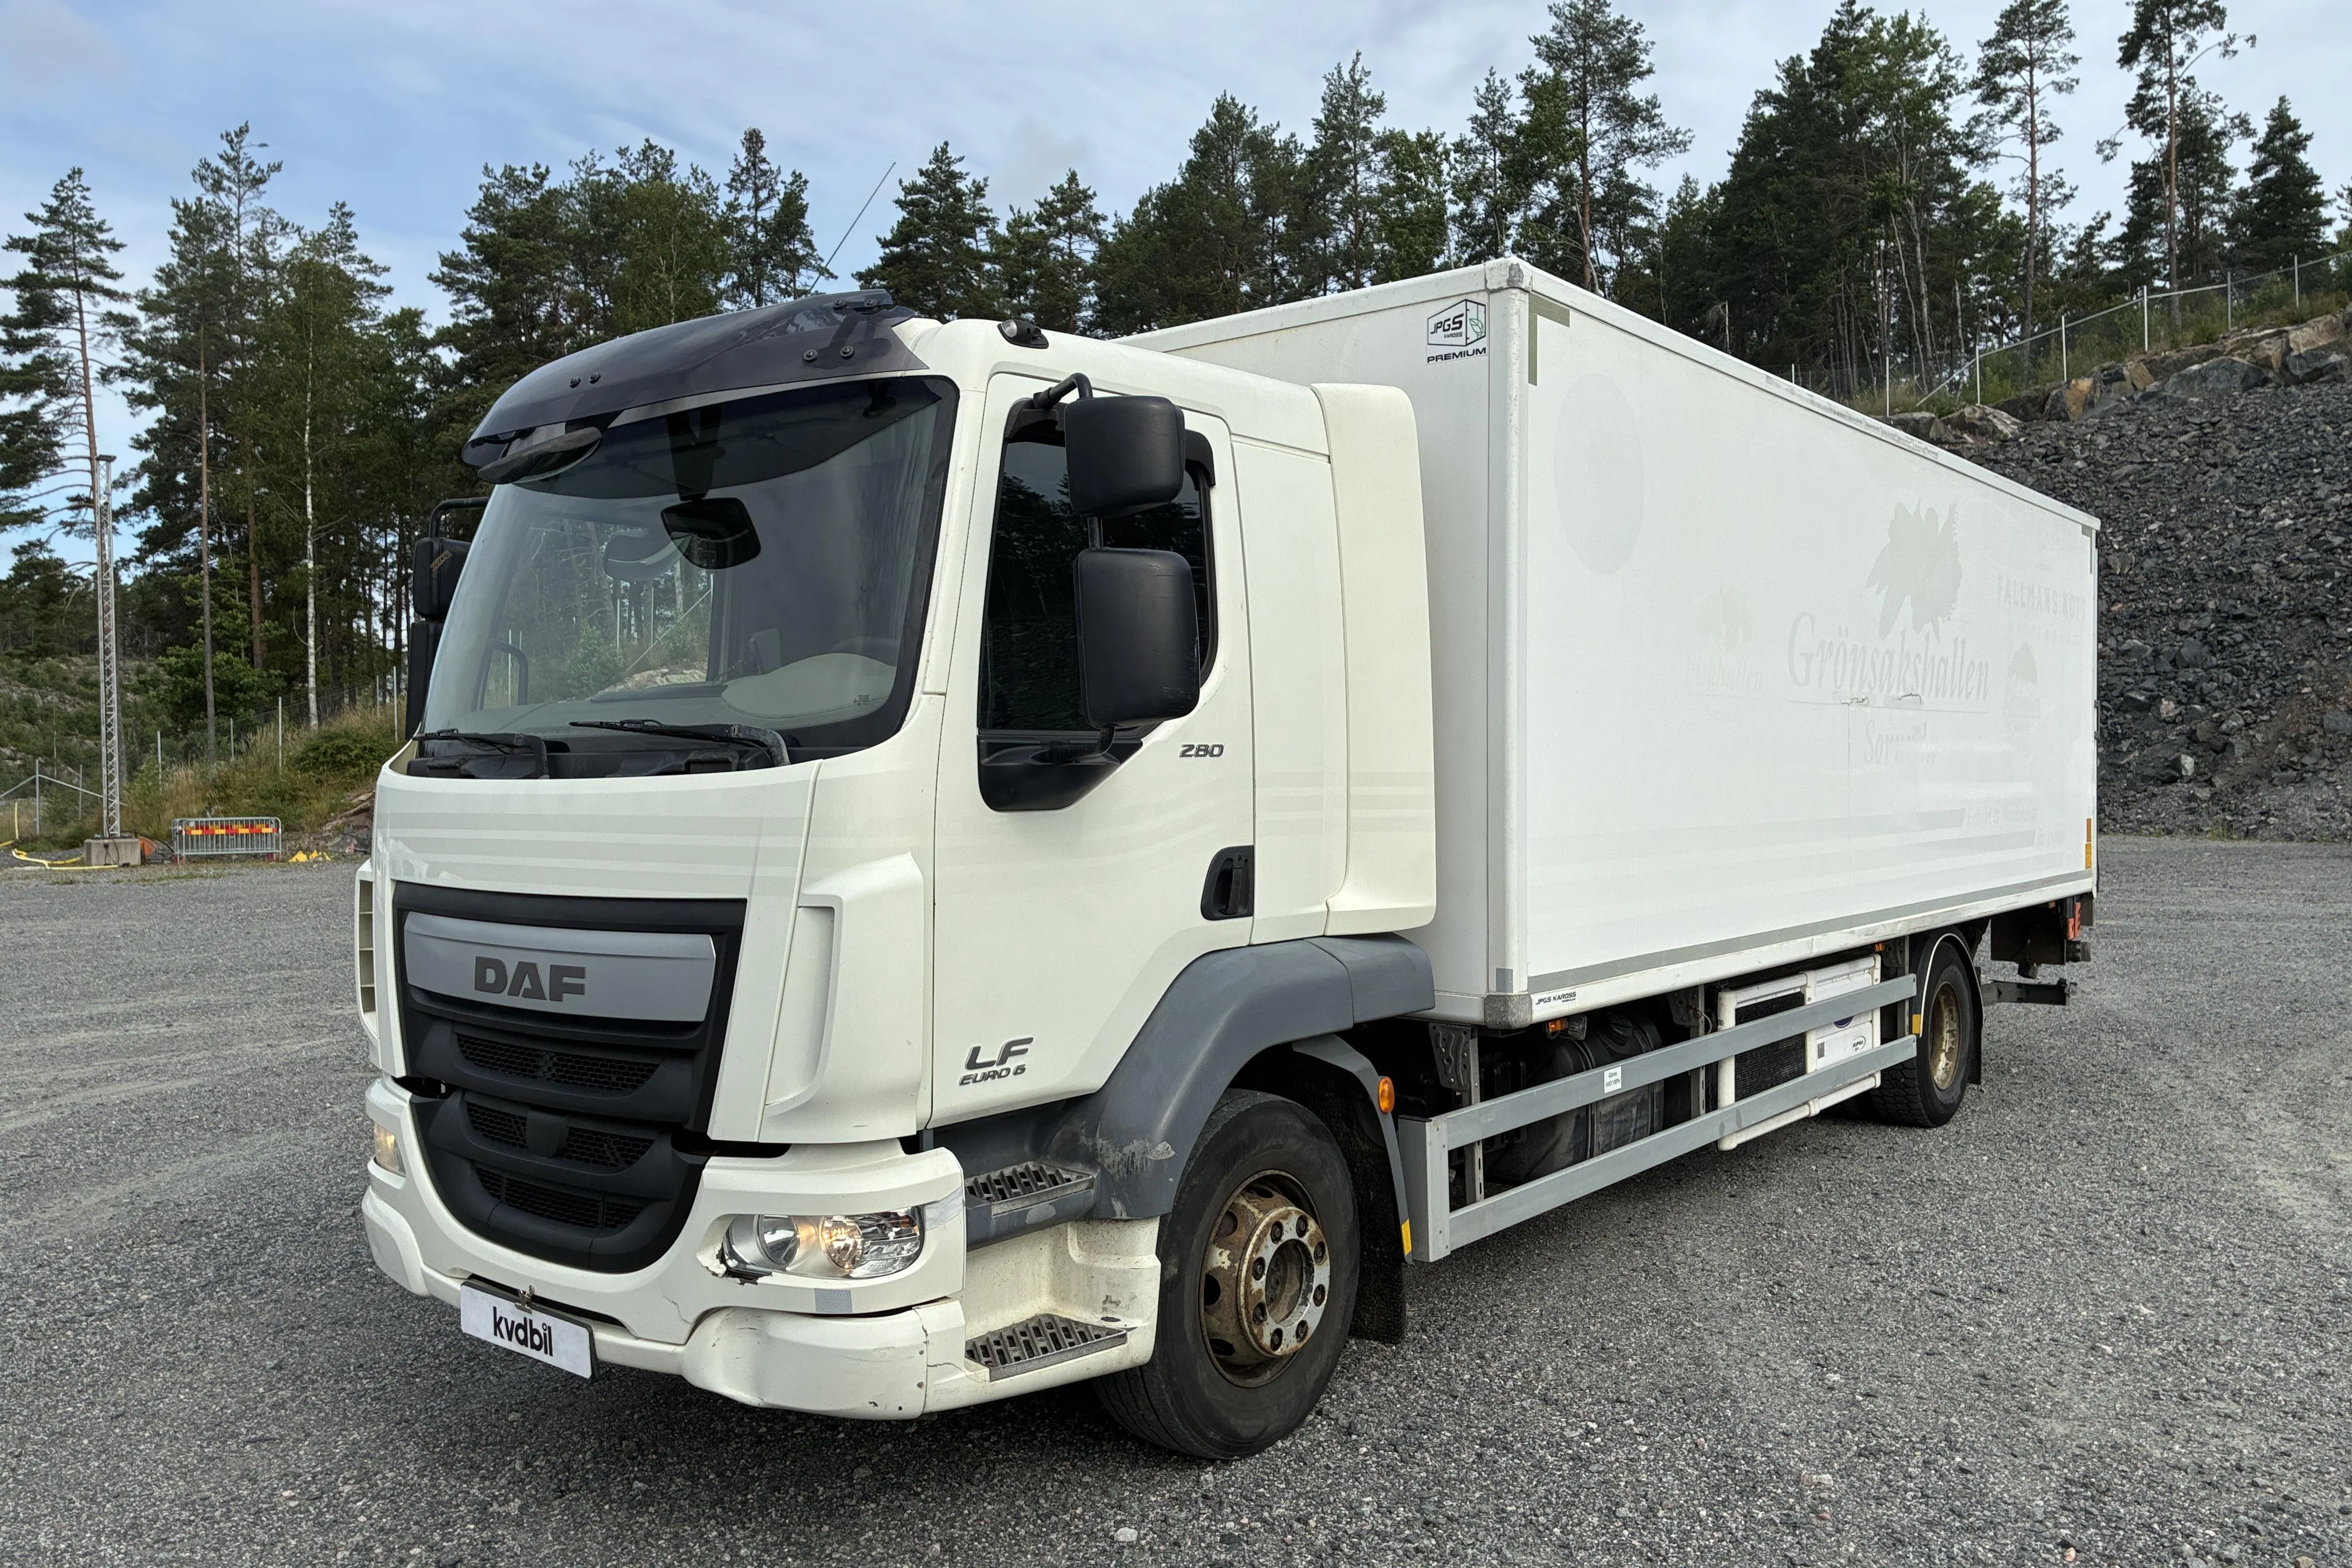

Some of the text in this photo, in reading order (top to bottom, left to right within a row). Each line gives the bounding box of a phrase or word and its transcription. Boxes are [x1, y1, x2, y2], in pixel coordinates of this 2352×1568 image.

[1430, 313, 1464, 334] JPGS
[1427, 347, 1486, 363] PREMIUM
[1788, 612, 1990, 701] Grönsakshallen
[1180, 744, 1224, 757] 280
[474, 956, 586, 1002] DAF
[1535, 992, 1577, 1005] JPGS KAROSS
[965, 1037, 1034, 1070] LF
[958, 1064, 1027, 1086] EURO 6
[493, 1306, 553, 1357] kvdbil
